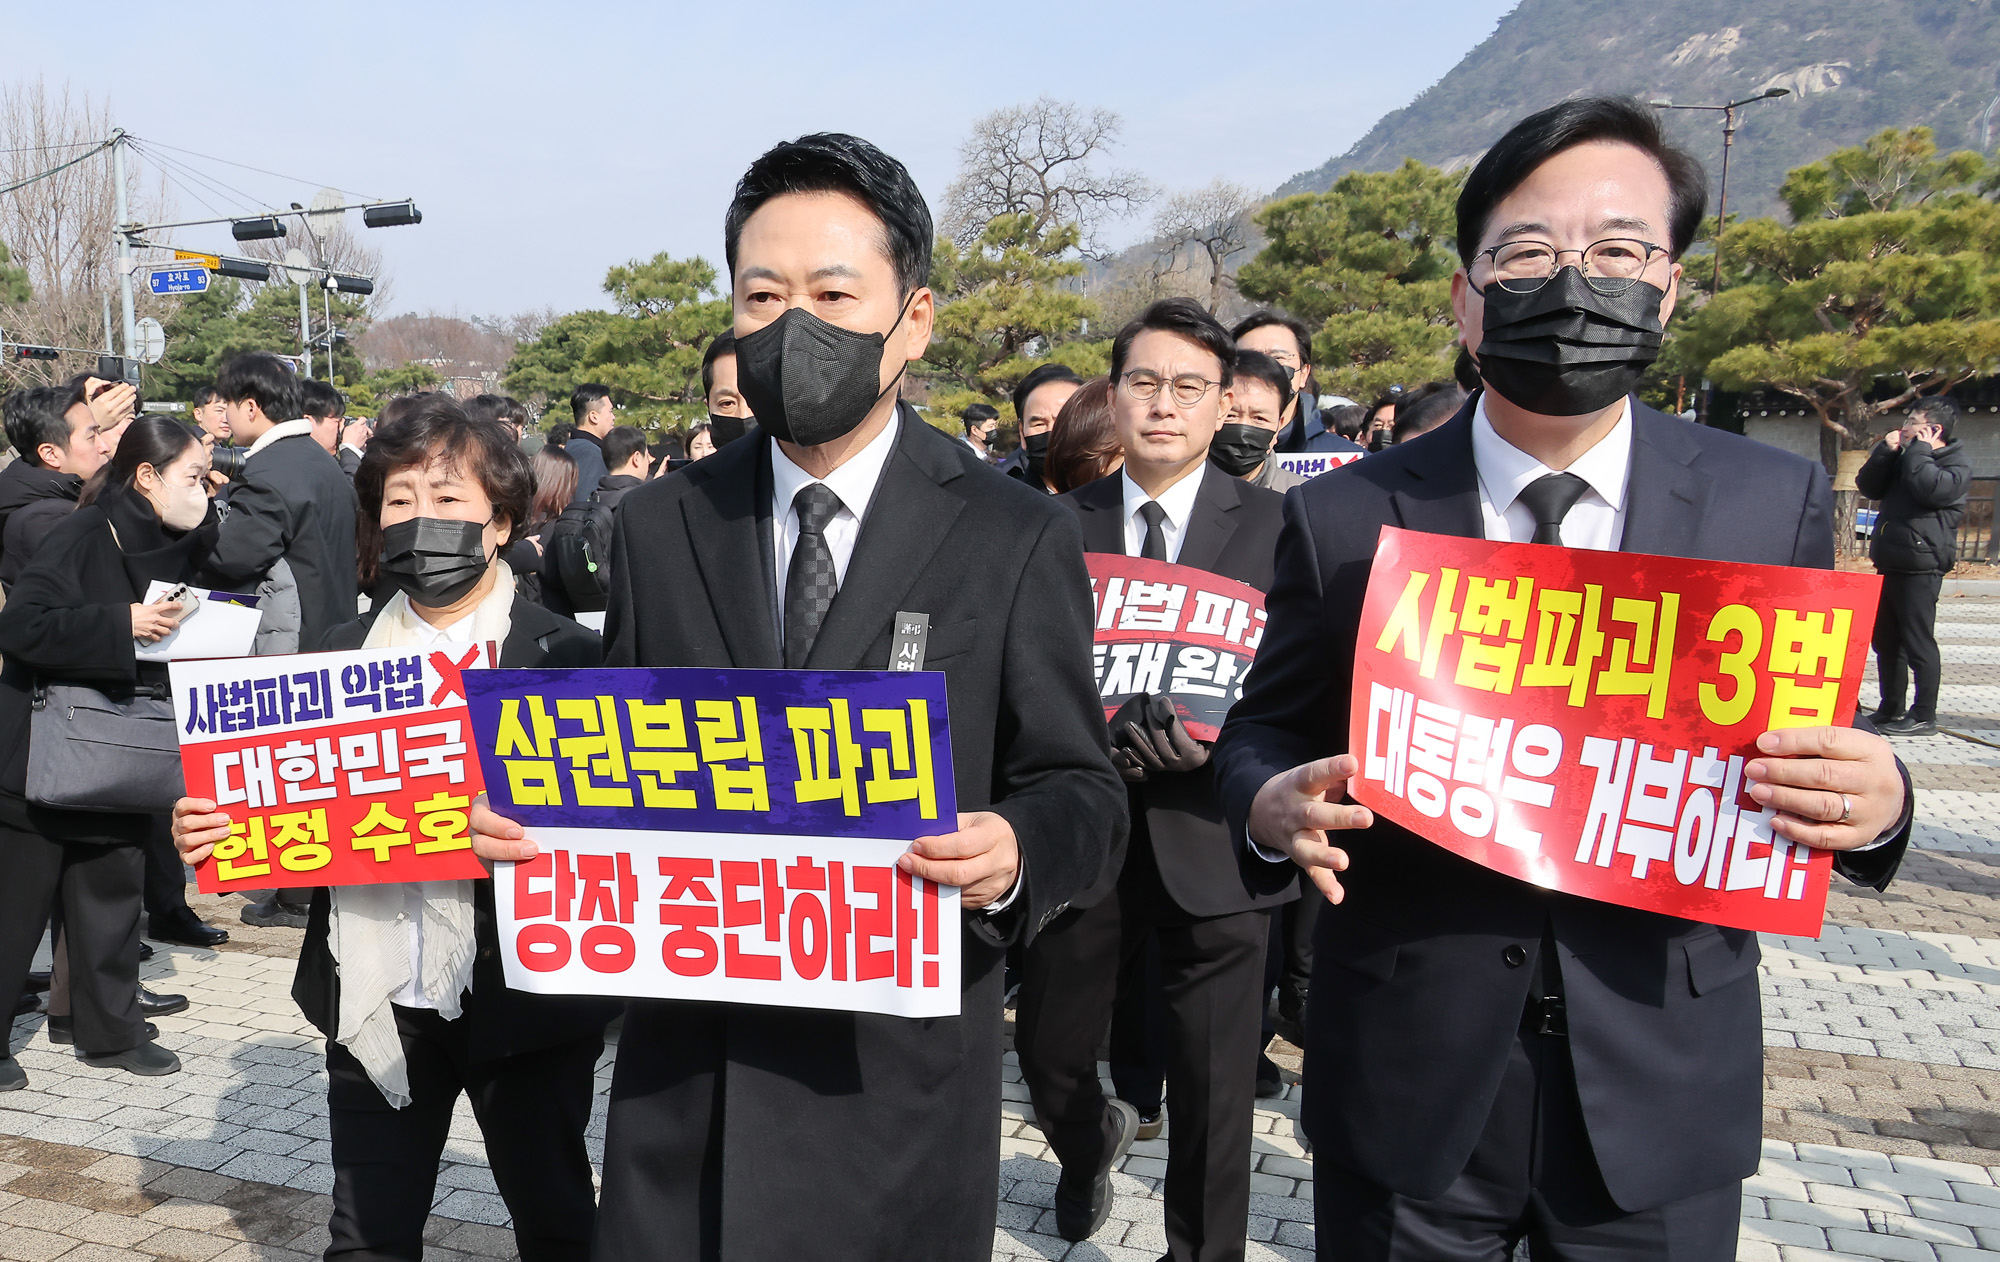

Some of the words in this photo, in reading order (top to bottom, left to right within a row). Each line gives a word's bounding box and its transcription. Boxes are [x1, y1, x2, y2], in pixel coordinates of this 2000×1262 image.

[152, 278, 160, 287] 97
[168, 272, 190, 282] 효자로
[168, 284, 191, 292] Hyoja-ro
[197, 276, 206, 284] 93
[1093, 642, 1172, 696] 재
[1169, 646, 1254, 700] 완
[1374, 566, 1681, 720] 사법파괴
[1698, 602, 1853, 732] 3법
[185, 669, 333, 735] 사법파괴
[341, 655, 424, 713] 악법
[212, 719, 467, 809] 대한민국
[494, 695, 771, 812] 삼권분립
[785, 697, 938, 820] 파괴
[1364, 681, 1563, 854] 대통령은
[211, 808, 333, 882] 헌정
[514, 849, 639, 973] 당장
[658, 856, 940, 988] 중단하라!
